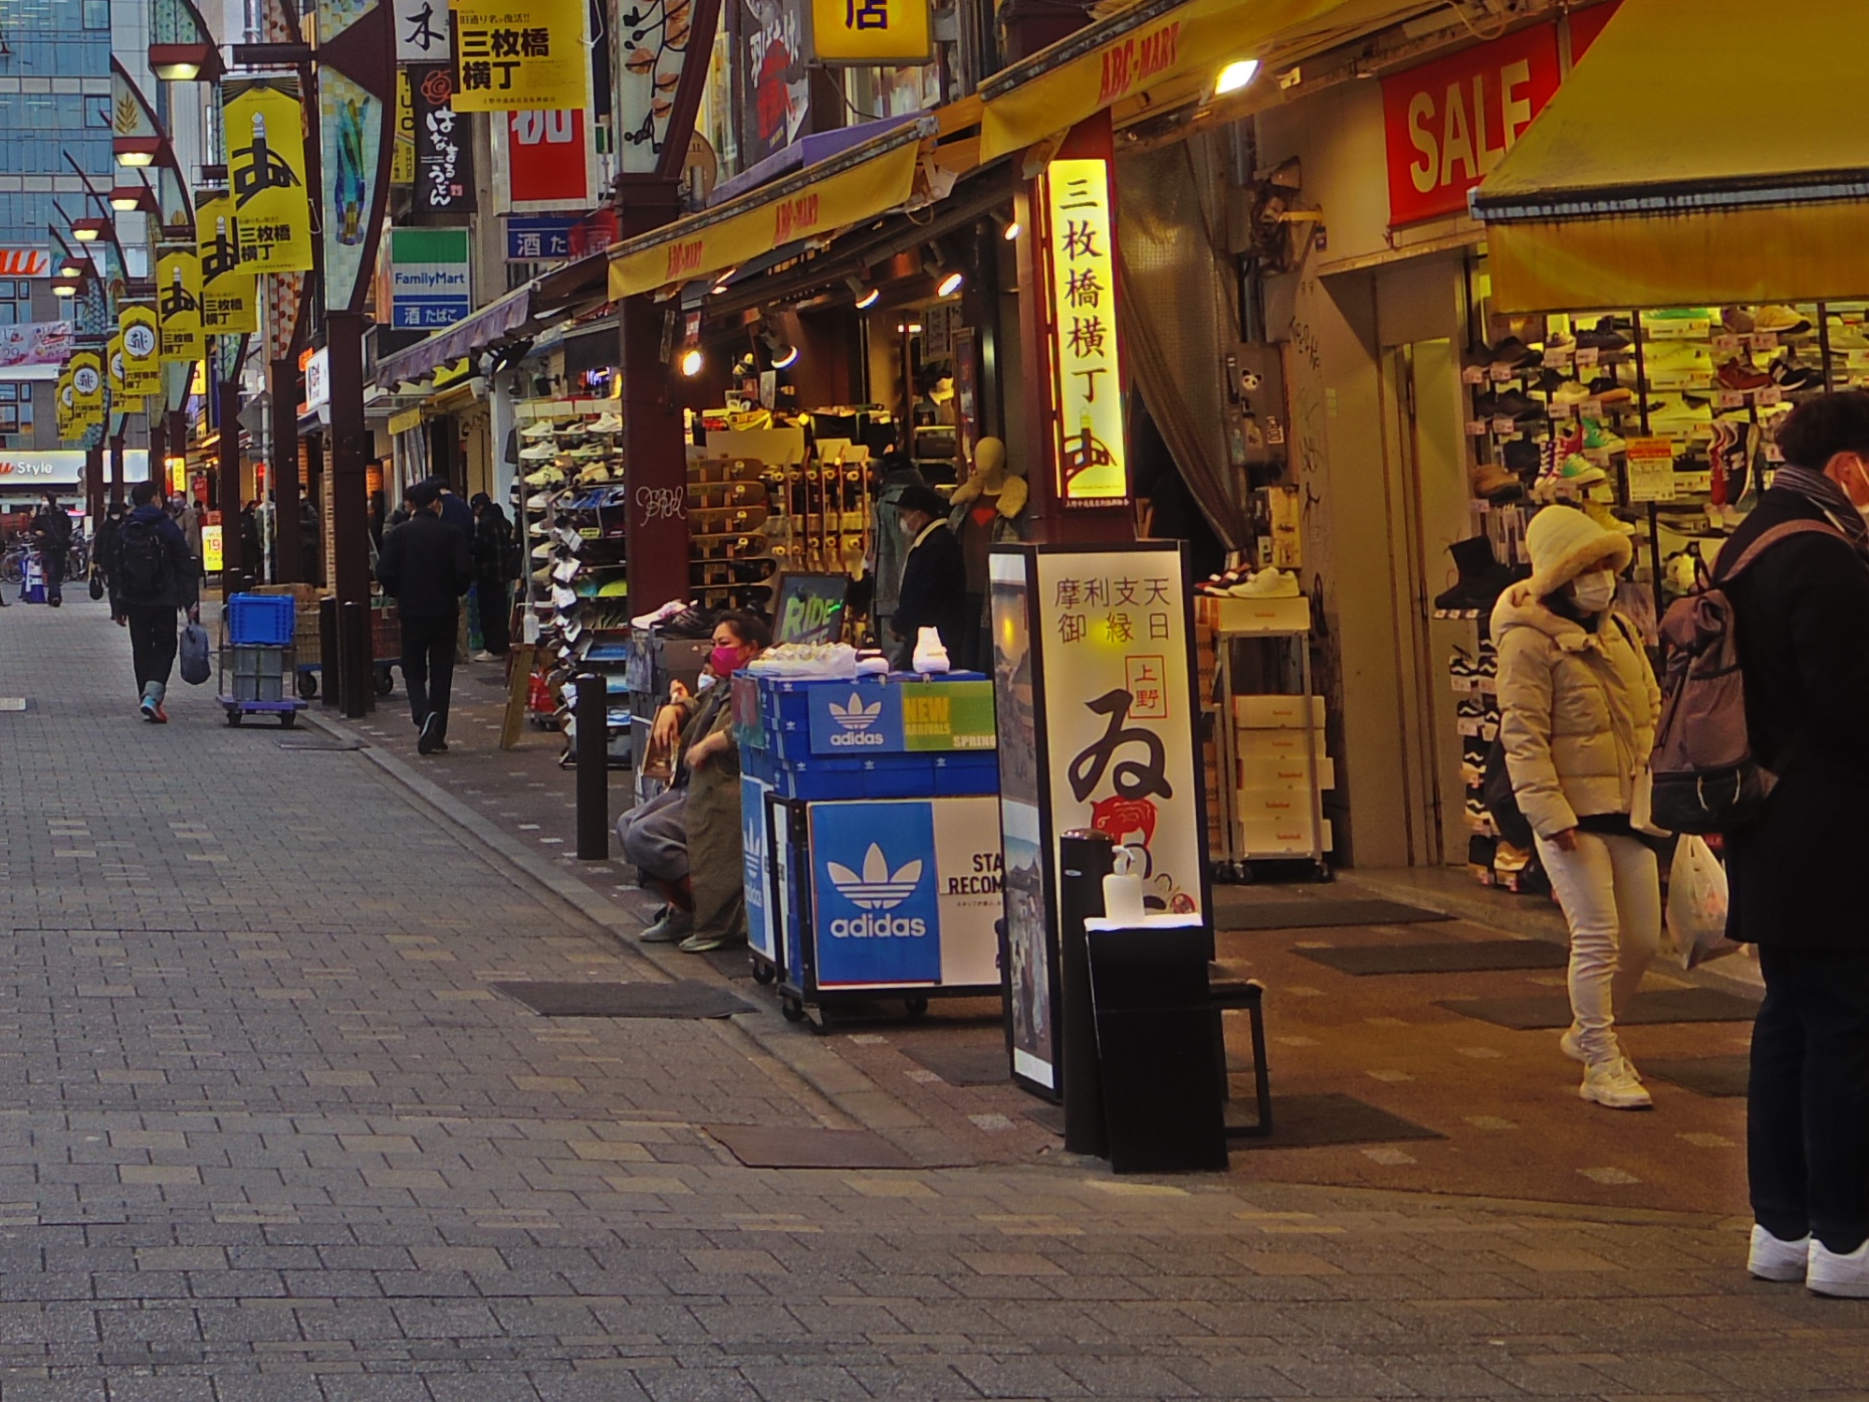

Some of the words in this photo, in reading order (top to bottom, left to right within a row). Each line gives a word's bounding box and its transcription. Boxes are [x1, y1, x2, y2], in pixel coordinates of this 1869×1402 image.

[462, 27, 549, 58] 三枚橋
[1097, 21, 1180, 105] ABC-MART
[462, 61, 521, 91] 横丁
[1407, 57, 1532, 194] SALE
[240, 225, 291, 243] 三枚橋
[517, 232, 542, 258] 酒
[241, 244, 274, 262] 横丁
[395, 272, 465, 287] FamilyMart
[1058, 176, 1107, 402] 三枚橋横丁
[205, 298, 243, 312] 三枚橋
[404, 307, 421, 326] 酒
[425, 308, 459, 323] たばこ
[16, 461, 53, 476] Style
[1054, 577, 1170, 608] 摩利支天
[1057, 613, 1170, 644] 御縁日
[1135, 663, 1158, 709] 上野
[905, 697, 950, 722] NEW
[831, 731, 884, 747] adidas
[905, 724, 951, 736] ARRIVALS
[953, 735, 997, 748] SPRING
[830, 915, 926, 939] adidas
